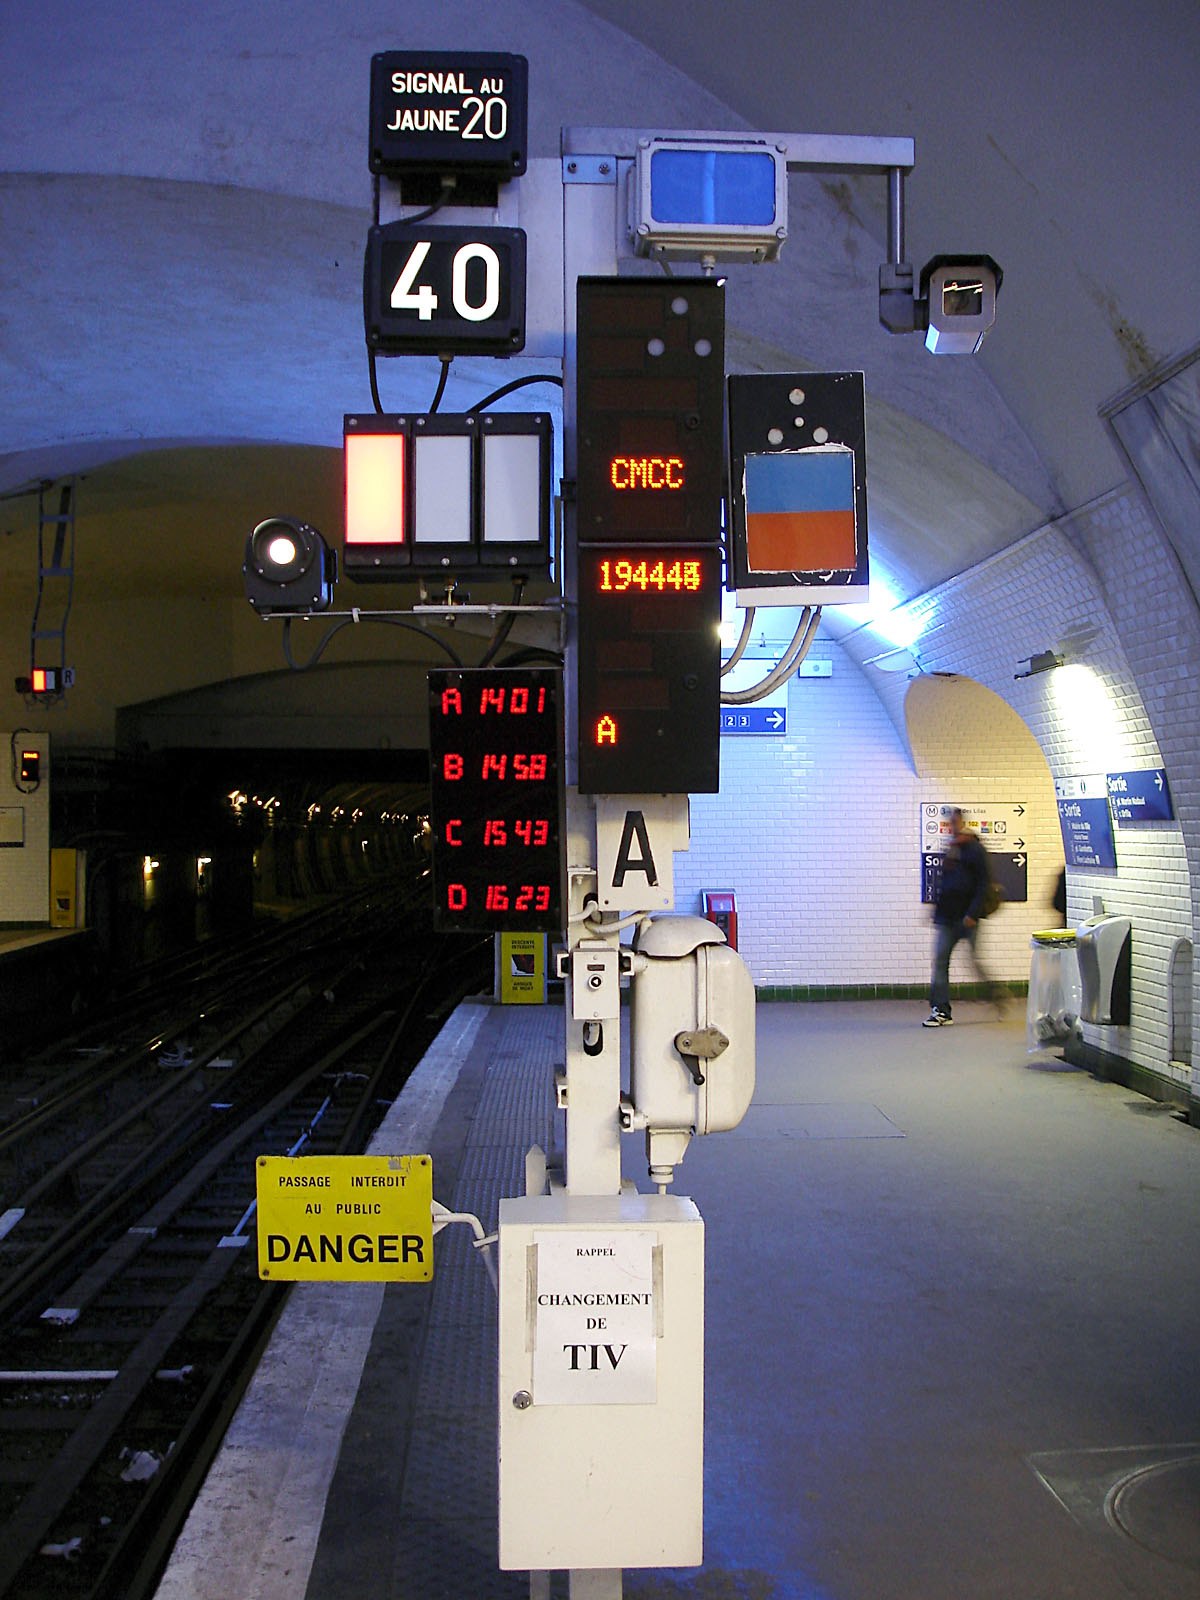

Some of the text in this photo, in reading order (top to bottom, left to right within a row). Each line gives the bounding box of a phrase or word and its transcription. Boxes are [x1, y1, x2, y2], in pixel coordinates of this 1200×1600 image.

[391, 72, 504, 95] SIGNAL AU
[386, 96, 508, 140] JAUNE 20
[390, 241, 500, 322] 40
[610, 457, 684, 489] CMCC
[64, 670, 72, 683] R
[442, 687, 463, 715] A
[594, 715, 618, 745] A
[727, 716, 748, 726] 2 3
[443, 753, 464, 781] B
[1107, 775, 1127, 792] Sortie
[1063, 802, 1081, 817] Sortie
[445, 819, 463, 847] C
[611, 810, 659, 888] A
[278, 1175, 407, 1188] PASSAGE INTERDIT
[305, 1203, 381, 1215] AU PUBLIC
[267, 1234, 425, 1264] DANGER
[576, 1248, 616, 1257] RAPPEL
[537, 1293, 652, 1307] CHANGEMENT
[586, 1317, 607, 1330] DE
[563, 1344, 628, 1371] TIV
